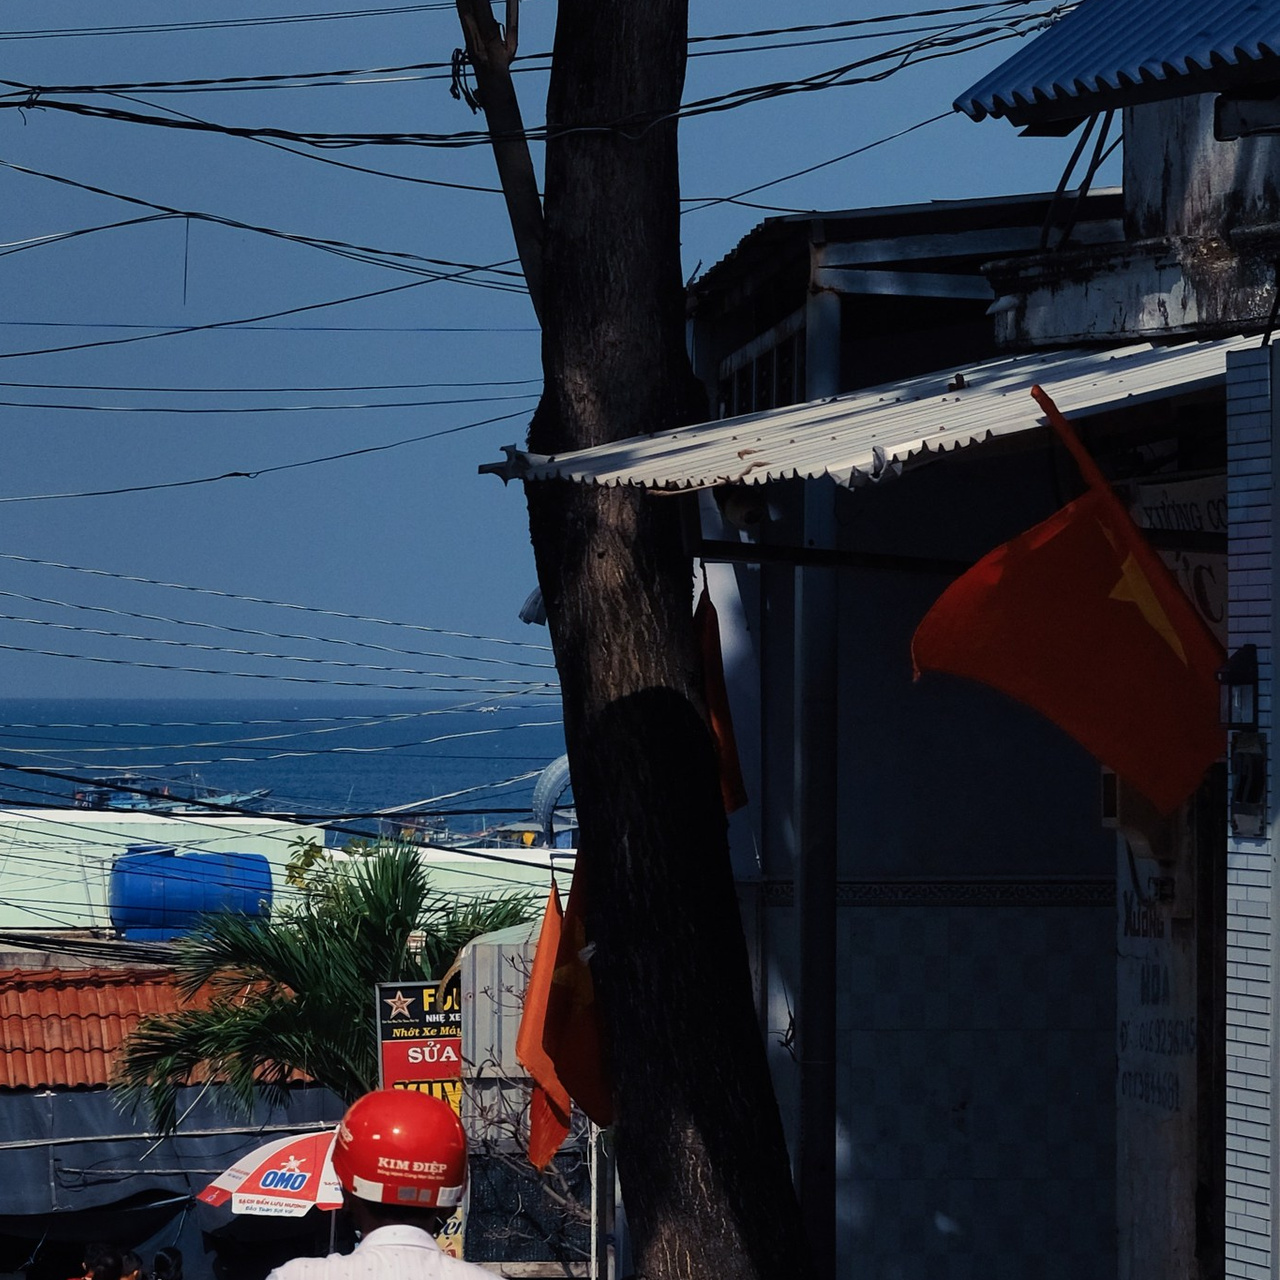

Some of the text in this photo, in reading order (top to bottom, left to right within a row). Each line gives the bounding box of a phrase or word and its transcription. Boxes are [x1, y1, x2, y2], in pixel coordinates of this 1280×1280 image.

[422, 1027, 438, 1036] Xe
[408, 1041, 458, 1063] SỬA
[378, 1156, 447, 1175] KIM ĐIỆP
[260, 1170, 308, 1191] OMO
